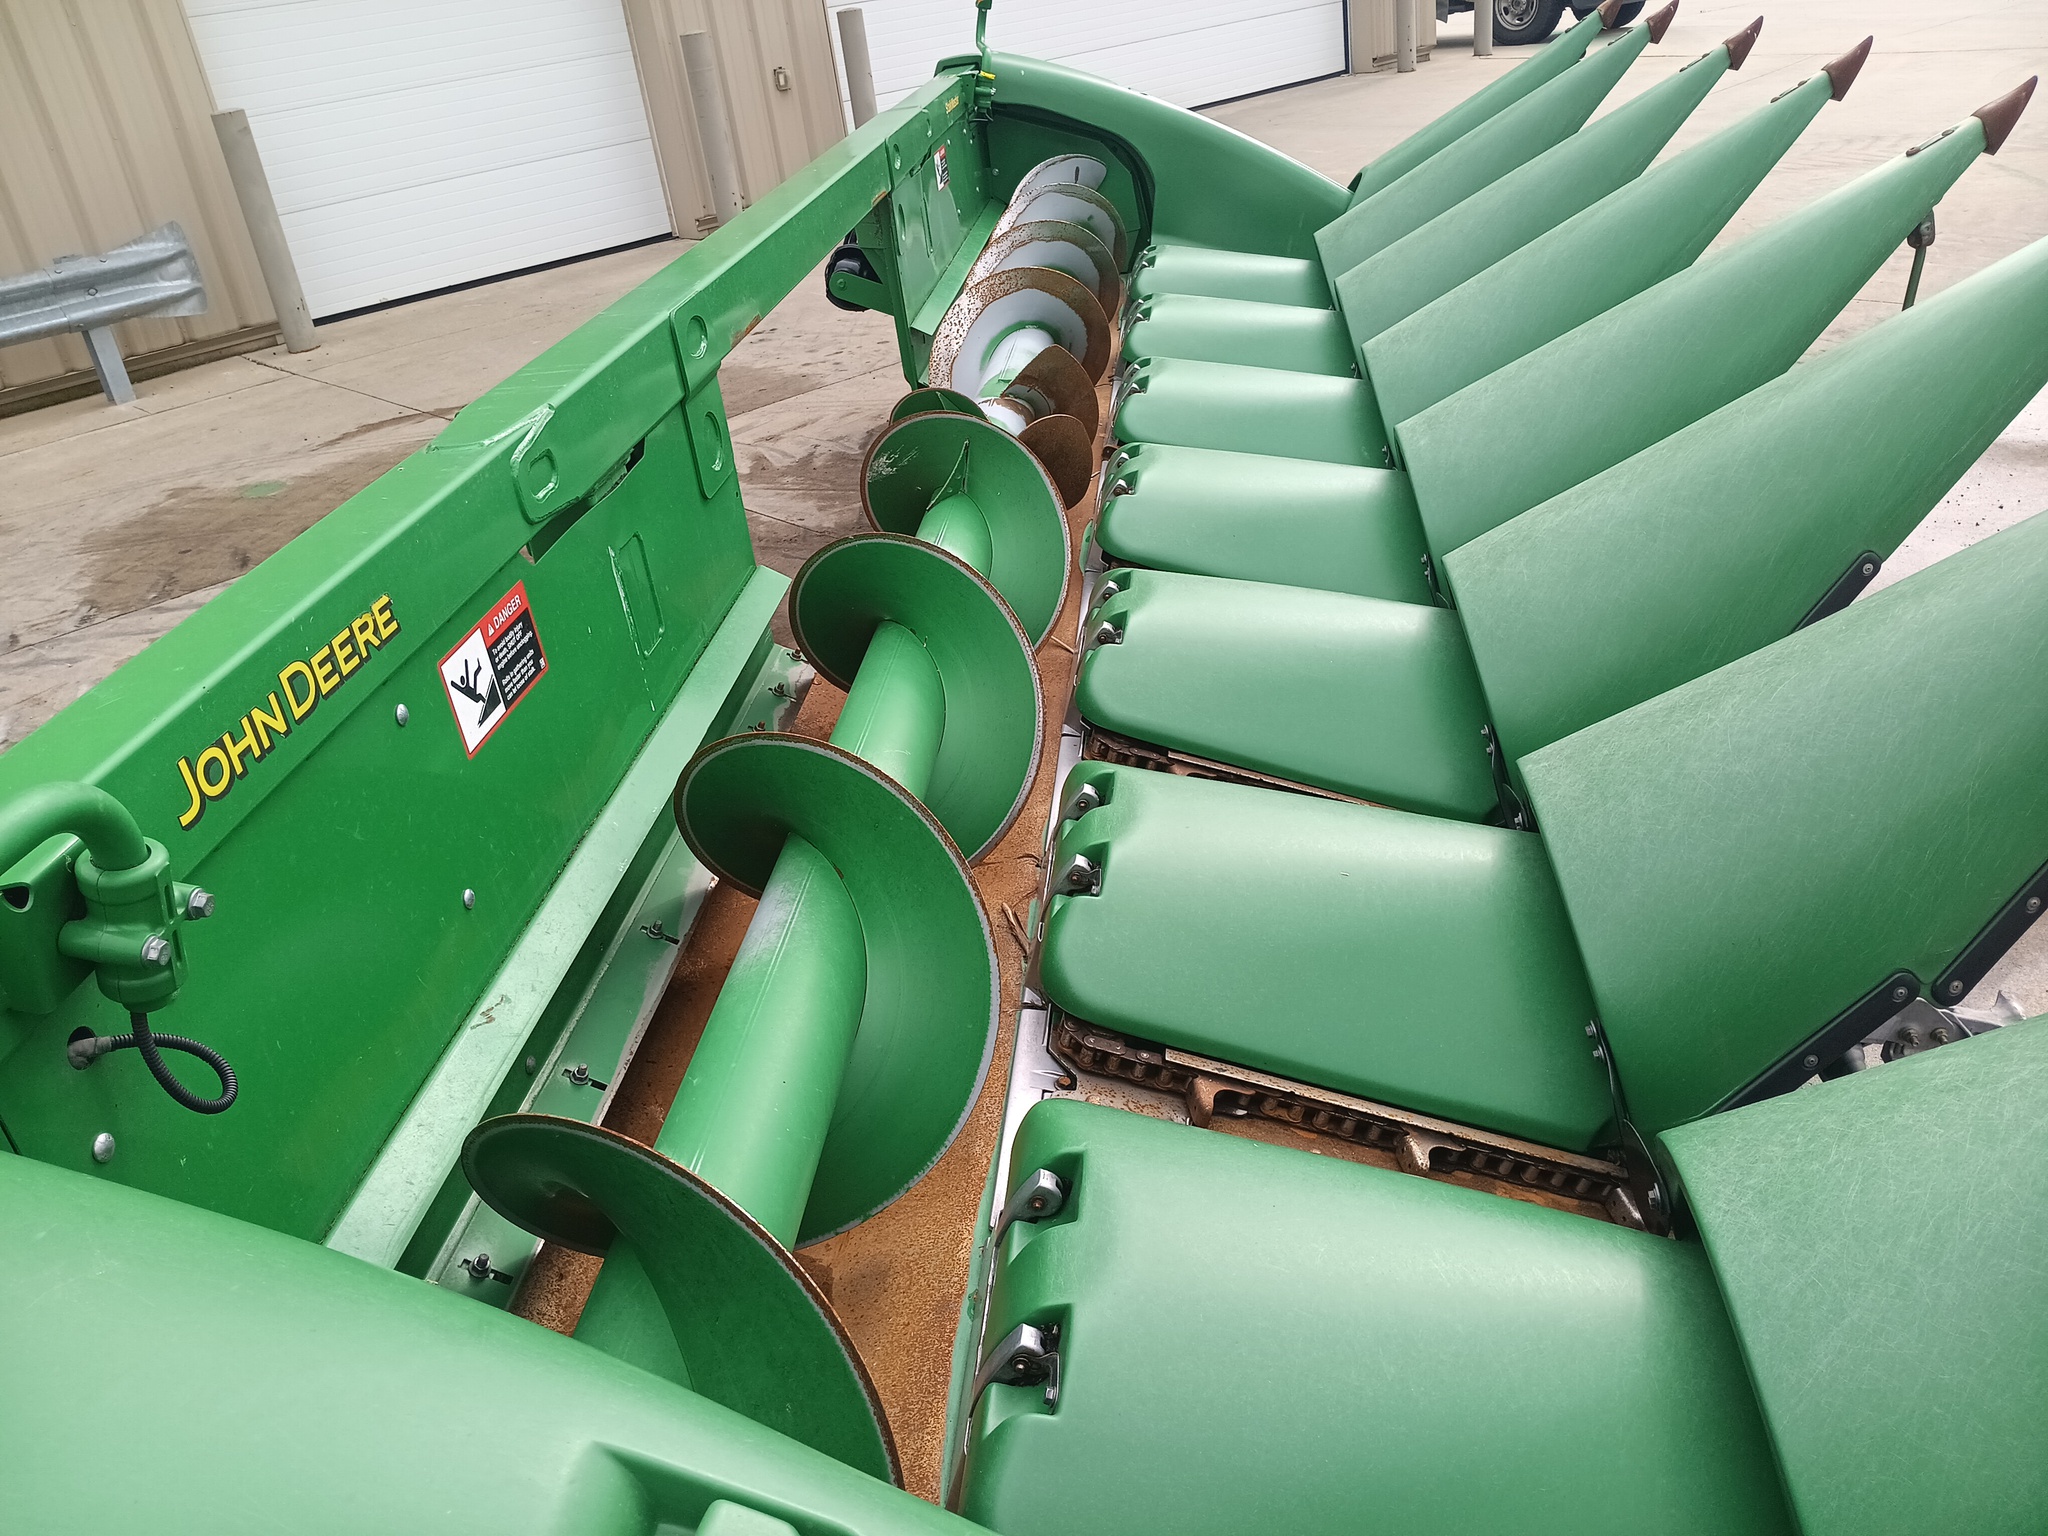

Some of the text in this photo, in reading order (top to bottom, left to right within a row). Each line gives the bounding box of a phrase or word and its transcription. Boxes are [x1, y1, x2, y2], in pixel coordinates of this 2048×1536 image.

[493, 594, 522, 630] DANGER
[497, 638, 506, 651] avoid
[505, 630, 515, 643] bodily
[515, 629, 523, 641] OFF
[497, 657, 508, 671] engine
[506, 647, 518, 660] before
[177, 592, 402, 831] JOHN DEERE
